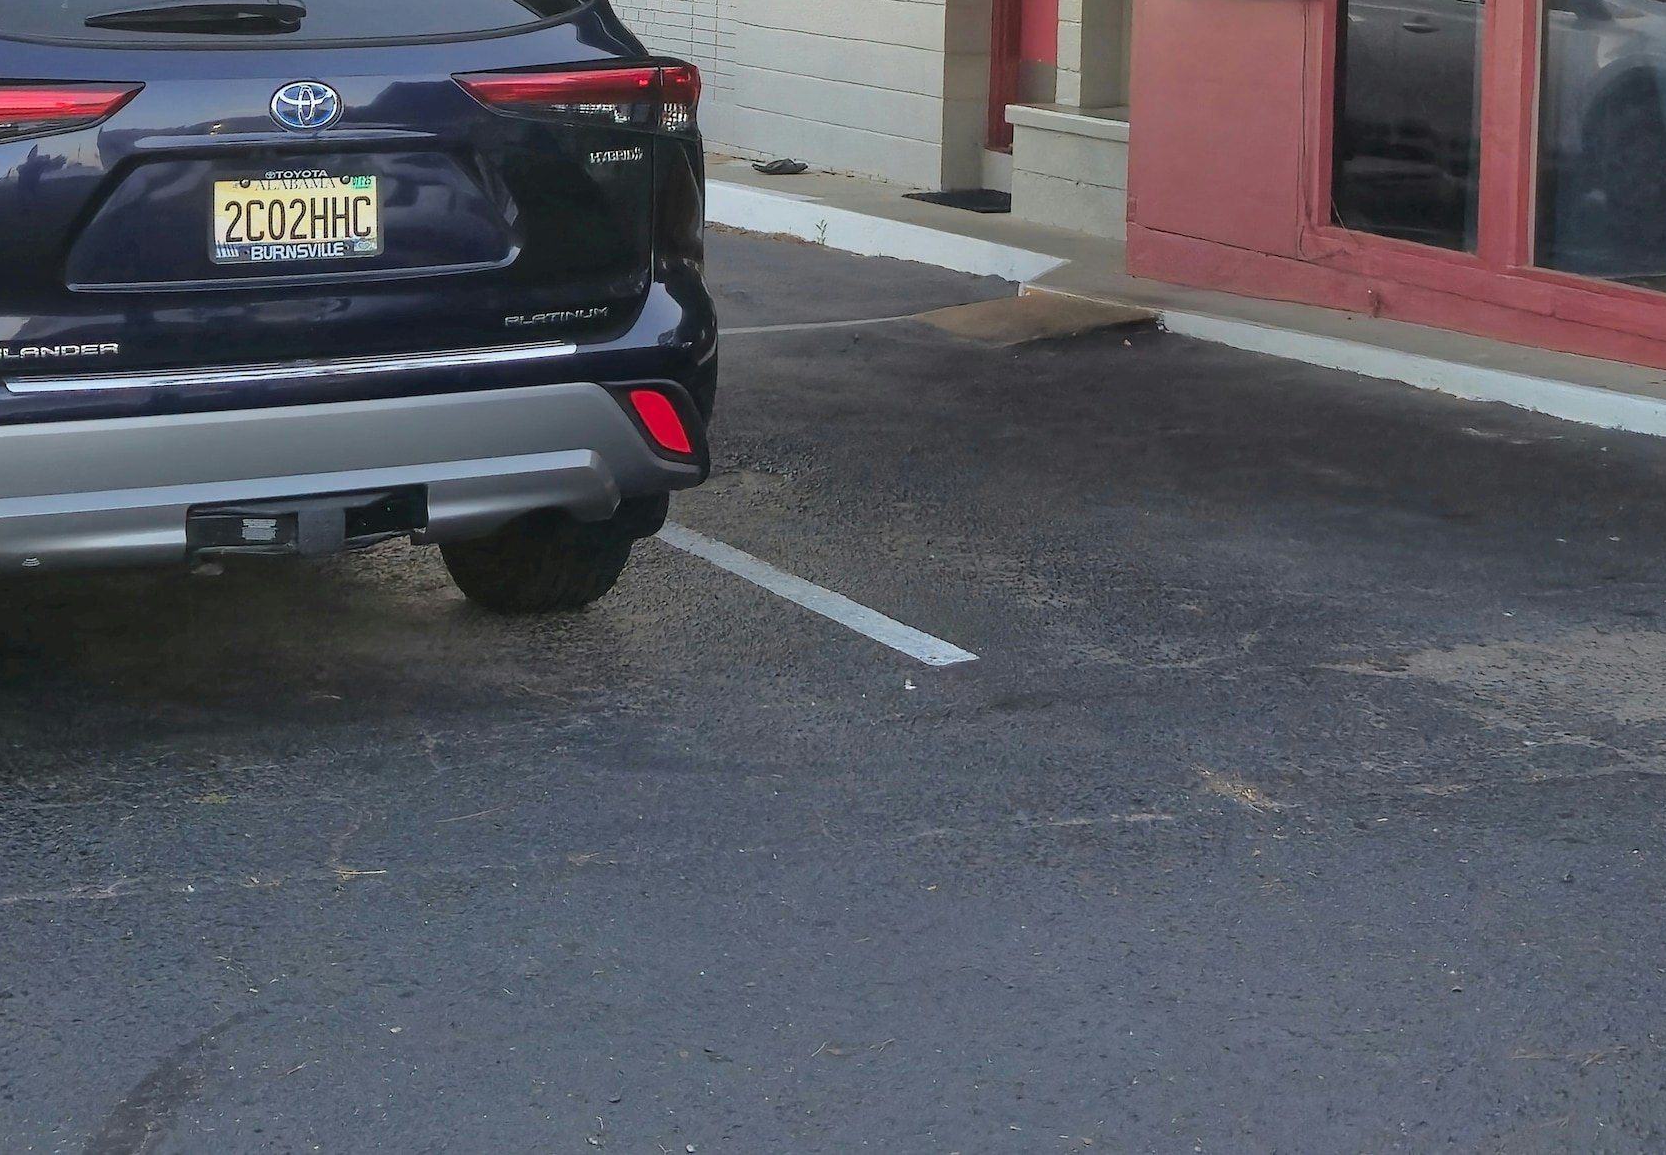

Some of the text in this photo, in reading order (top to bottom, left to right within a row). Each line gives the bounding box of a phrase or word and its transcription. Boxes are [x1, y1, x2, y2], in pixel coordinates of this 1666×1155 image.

[275, 169, 328, 179] TOYOTA
[255, 178, 336, 191] ALABAMA
[224, 196, 372, 243] 2C02HHC
[251, 242, 345, 261] BURNSVILLE
[504, 306, 608, 326] PLATINUM
